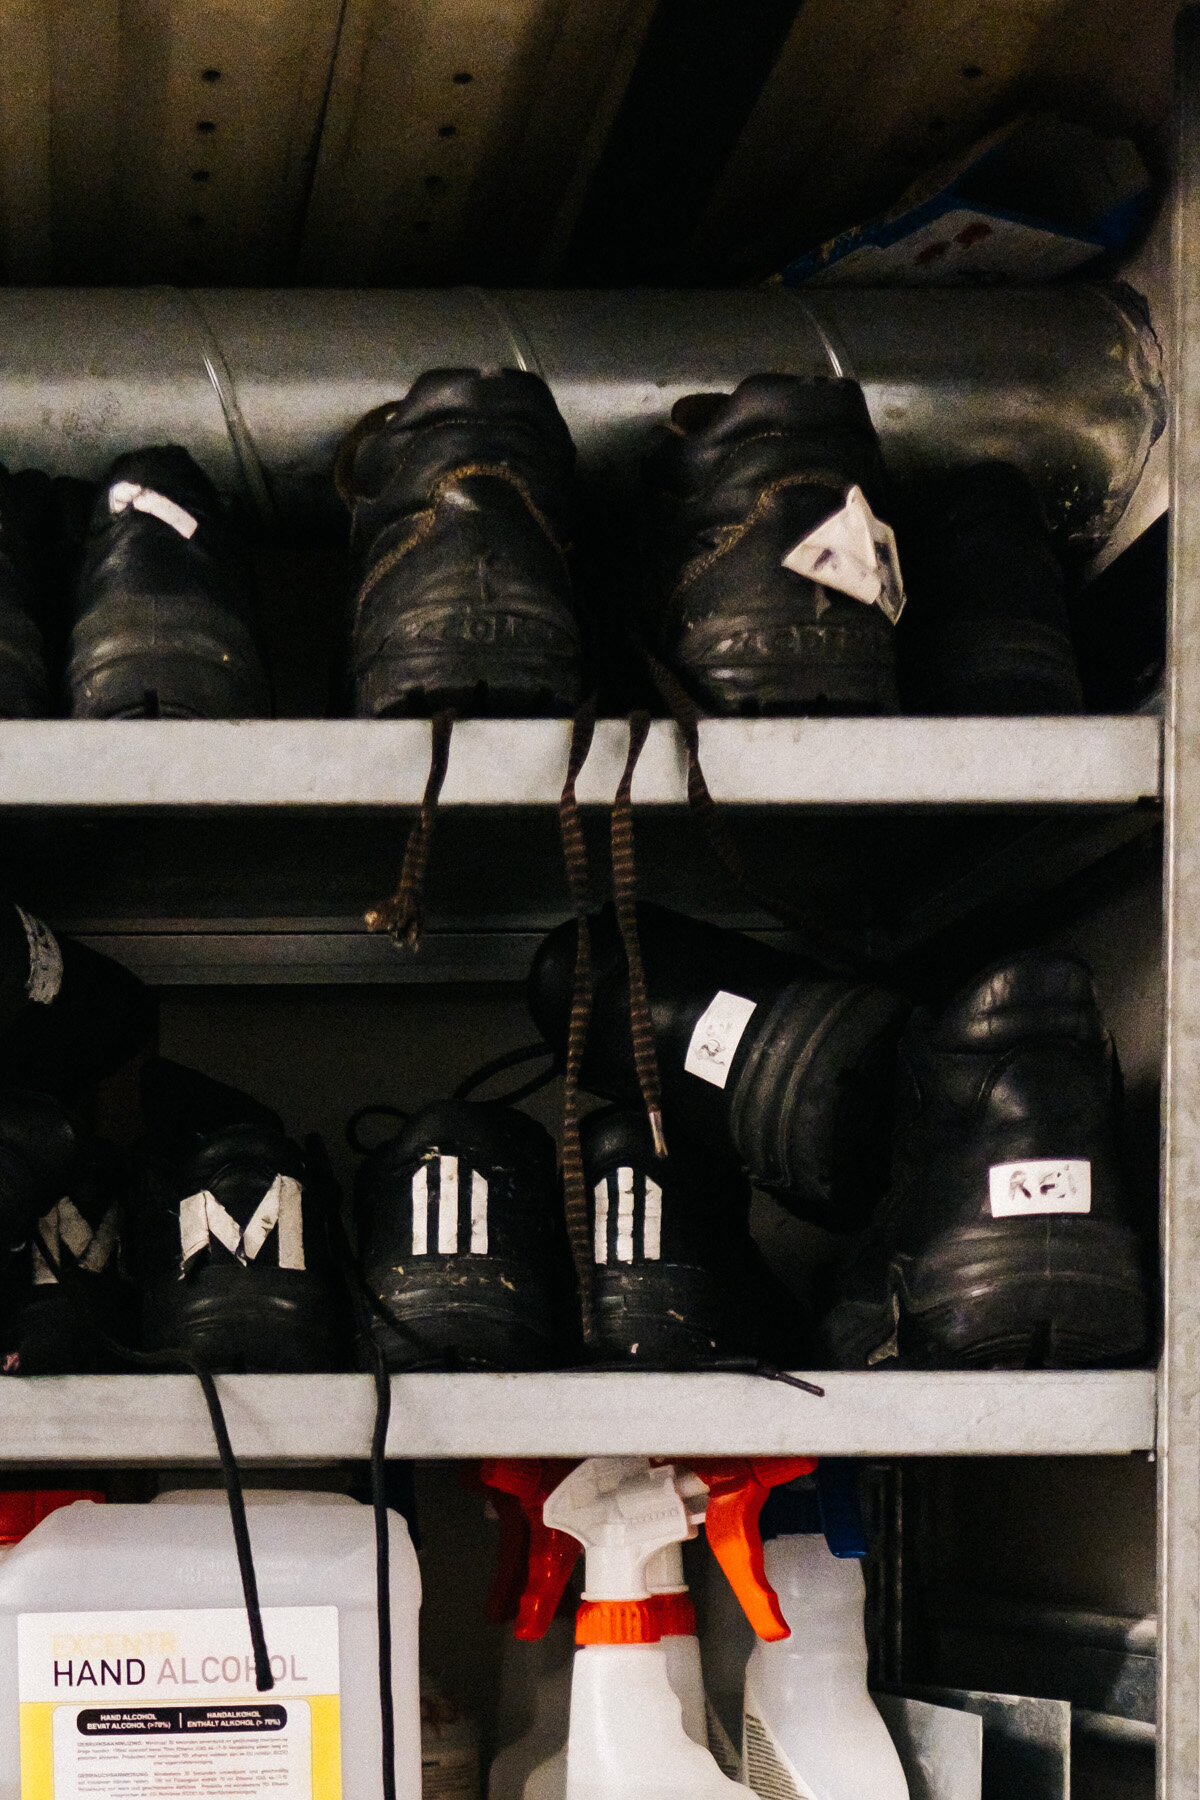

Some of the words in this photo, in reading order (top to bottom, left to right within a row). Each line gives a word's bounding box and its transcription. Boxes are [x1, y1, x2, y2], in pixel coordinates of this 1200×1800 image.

[53, 1658, 146, 1687] HAND
[100, 1713, 121, 1721] HAND
[122, 1713, 157, 1721] ALCOHOL
[87, 1721, 110, 1730] BEVAT
[111, 1721, 145, 1729] ALCOHOL
[221, 1719, 255, 1727] ALKOHOL
